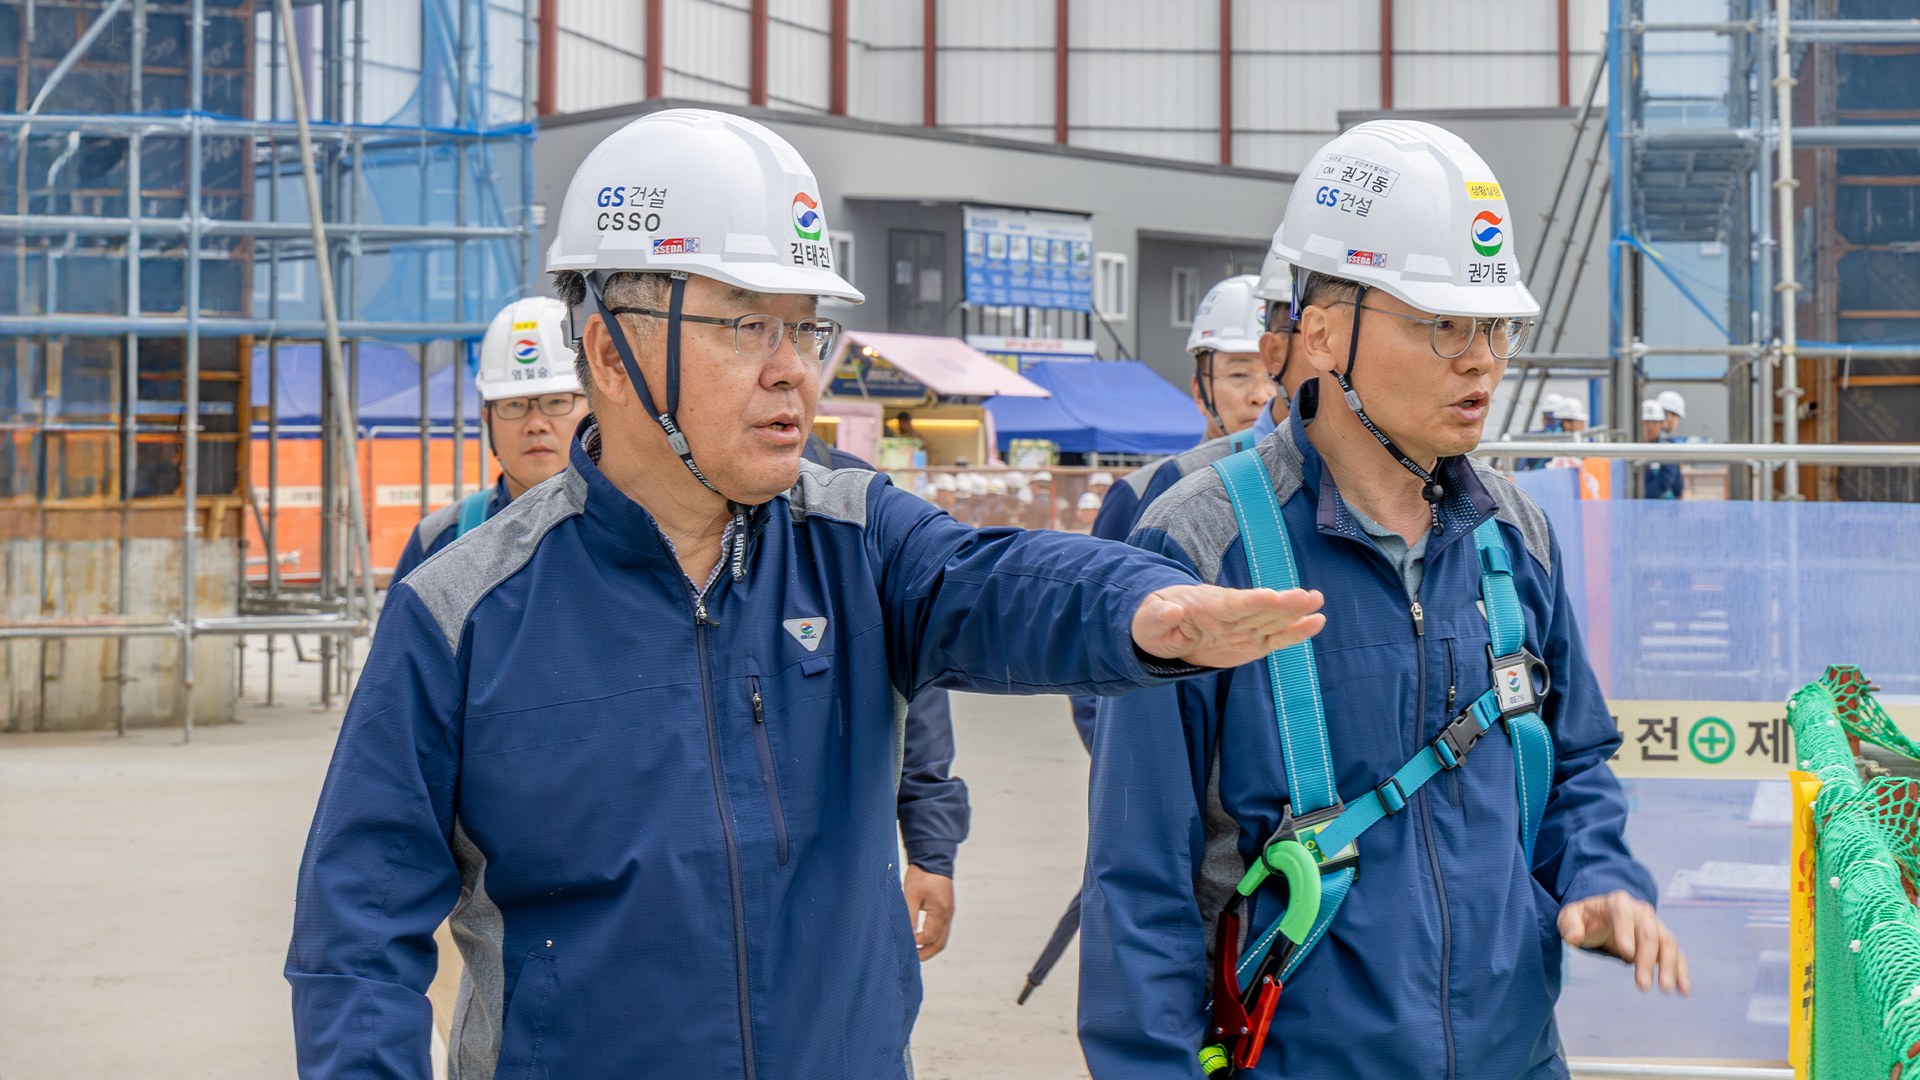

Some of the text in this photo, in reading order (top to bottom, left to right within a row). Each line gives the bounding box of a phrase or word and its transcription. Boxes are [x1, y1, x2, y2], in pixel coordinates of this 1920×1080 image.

[1341, 165, 1389, 193] 권기동
[597, 212, 662, 233] CSSO
[790, 242, 831, 269] 김태진
[1468, 262, 1508, 284] 권기동
[1372, 430, 1391, 446] FIRST
[1400, 457, 1422, 474] SAFETY
[1430, 503, 1439, 527] SAFET
[733, 533, 745, 561] SAFETY
